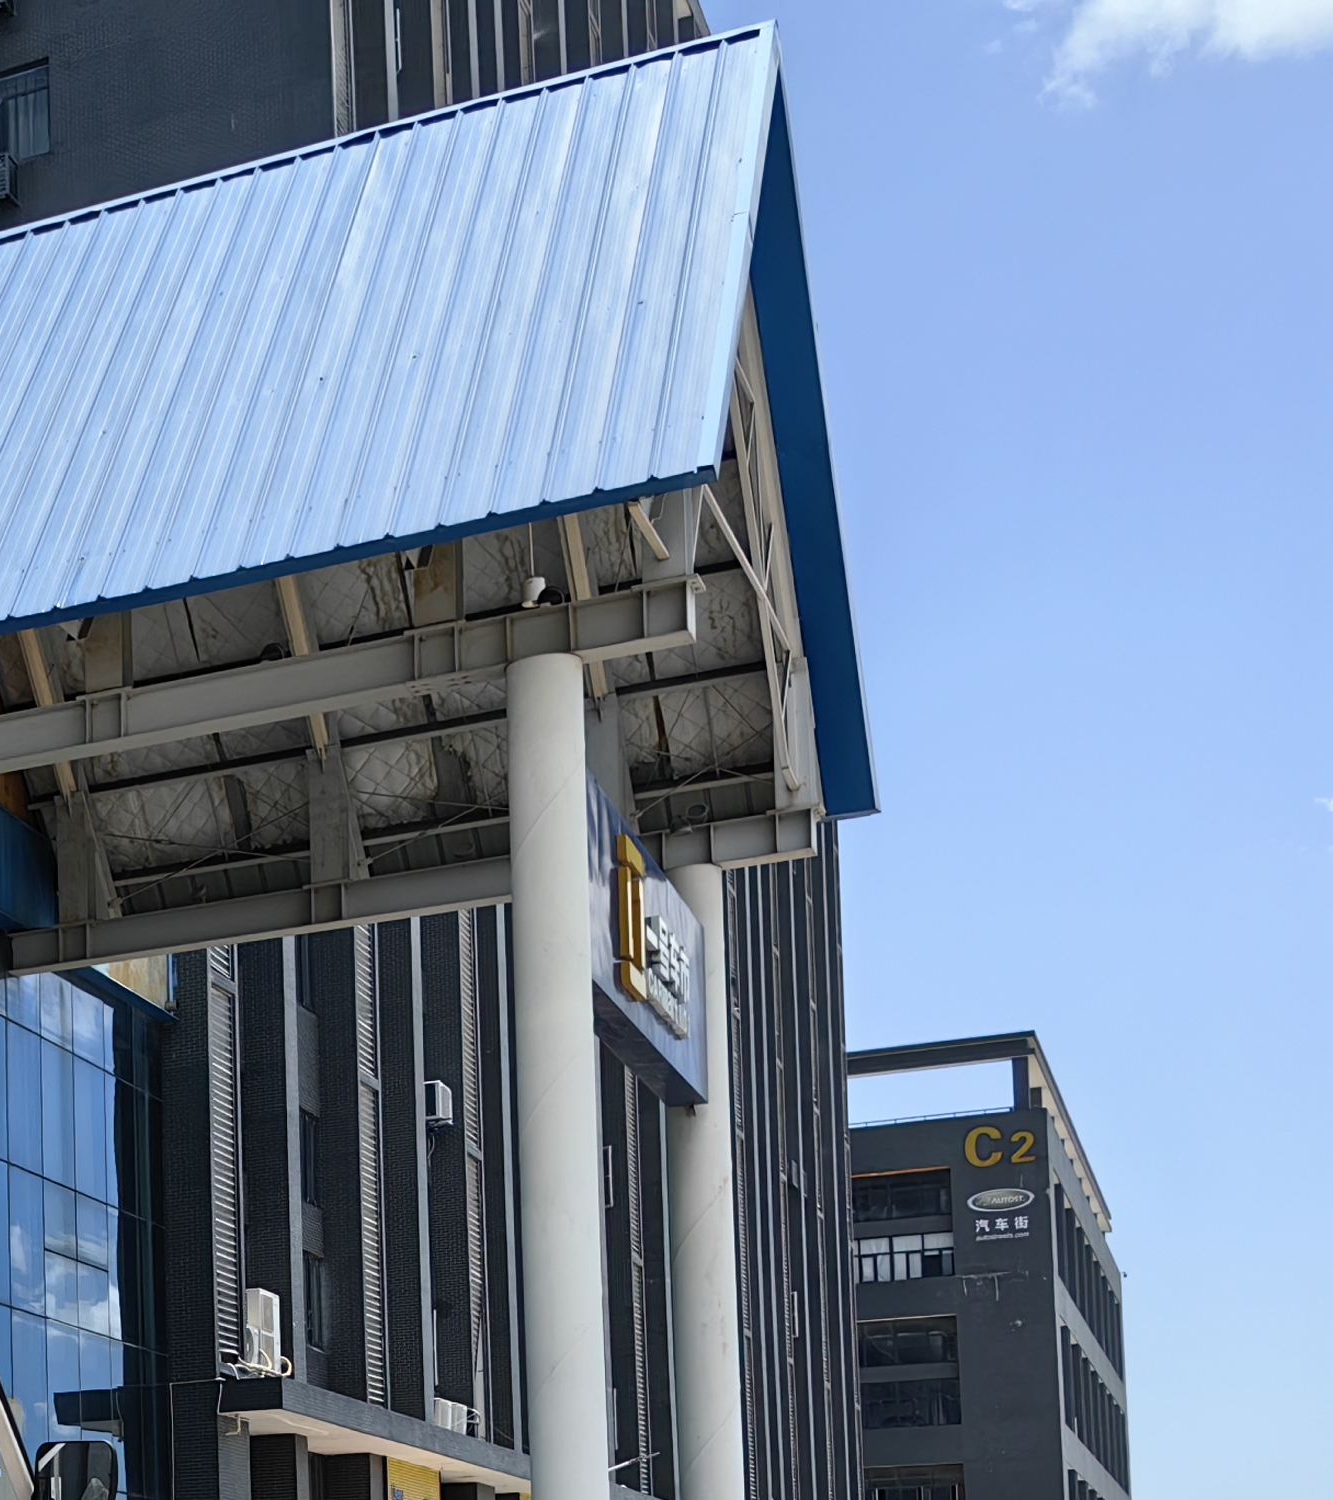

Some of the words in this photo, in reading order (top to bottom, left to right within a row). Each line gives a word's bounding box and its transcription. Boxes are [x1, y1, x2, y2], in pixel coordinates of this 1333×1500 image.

[964, 1126, 1036, 1168] C2
[975, 1215, 1029, 1233] 汽车街
